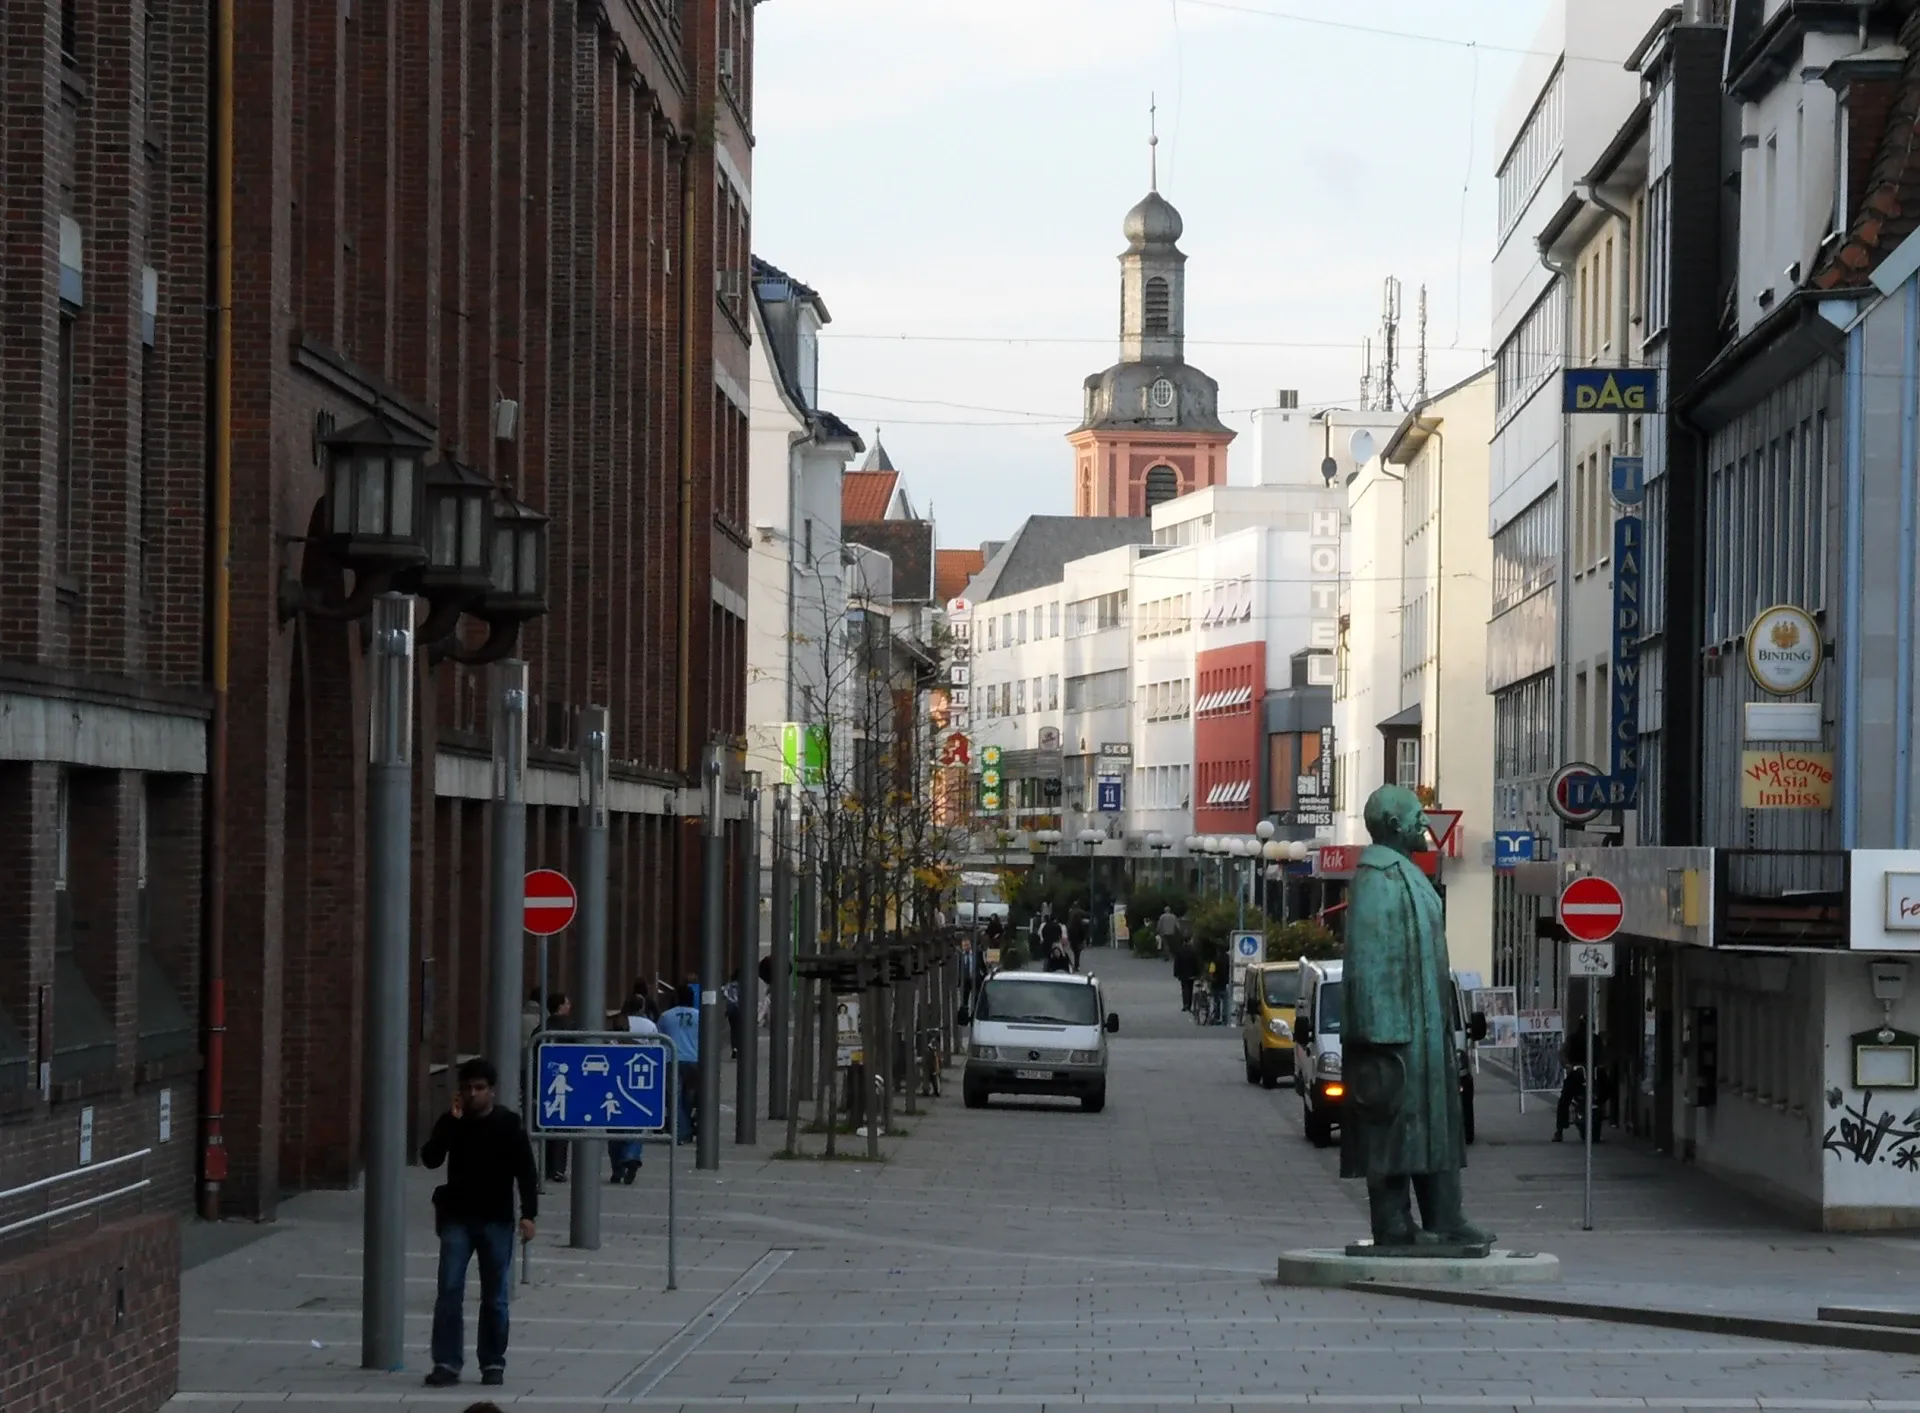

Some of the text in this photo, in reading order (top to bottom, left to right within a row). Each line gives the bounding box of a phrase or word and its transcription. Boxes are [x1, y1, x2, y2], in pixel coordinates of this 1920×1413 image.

[1575, 372, 1645, 409] DAG
[1310, 510, 1338, 685] HOTEL
[1616, 523, 1639, 769] LANDEWYCK
[954, 623, 968, 727] HOTEL
[1104, 744, 1129, 754] SEB
[1745, 751, 1833, 784] Welcome
[1768, 770, 1808, 788] Asia
[1759, 788, 1820, 806] Imbiss
[1297, 813, 1330, 824] IMBISS
[1323, 850, 1344, 868] kik
